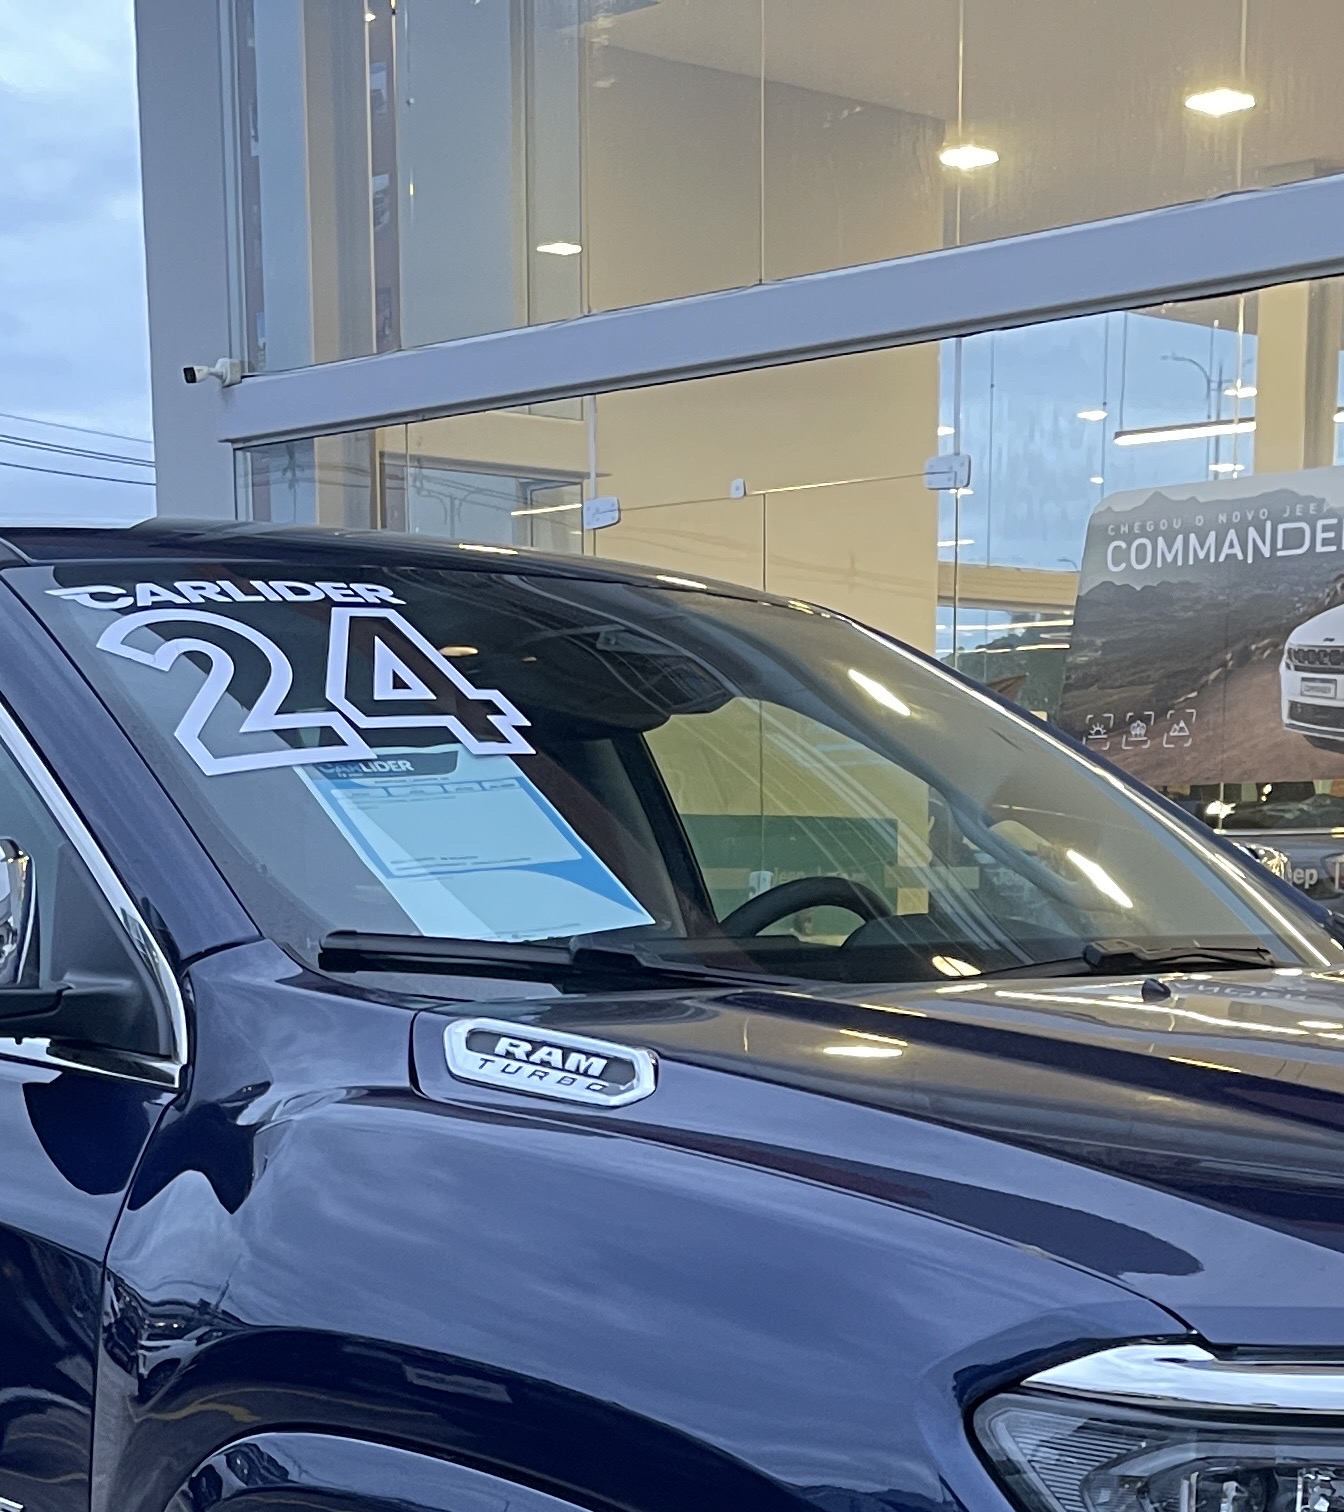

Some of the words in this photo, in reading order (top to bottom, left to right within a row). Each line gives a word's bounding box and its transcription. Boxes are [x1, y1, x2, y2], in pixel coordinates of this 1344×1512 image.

[1107, 517, 1183, 537] CHEGOU
[1195, 514, 1204, 527] O
[1218, 507, 1269, 525] NOVO
[45, 579, 407, 610] CARLIDER
[96, 606, 537, 777] 24
[494, 1036, 608, 1077] RAM
[478, 1057, 610, 1092] TURBO
